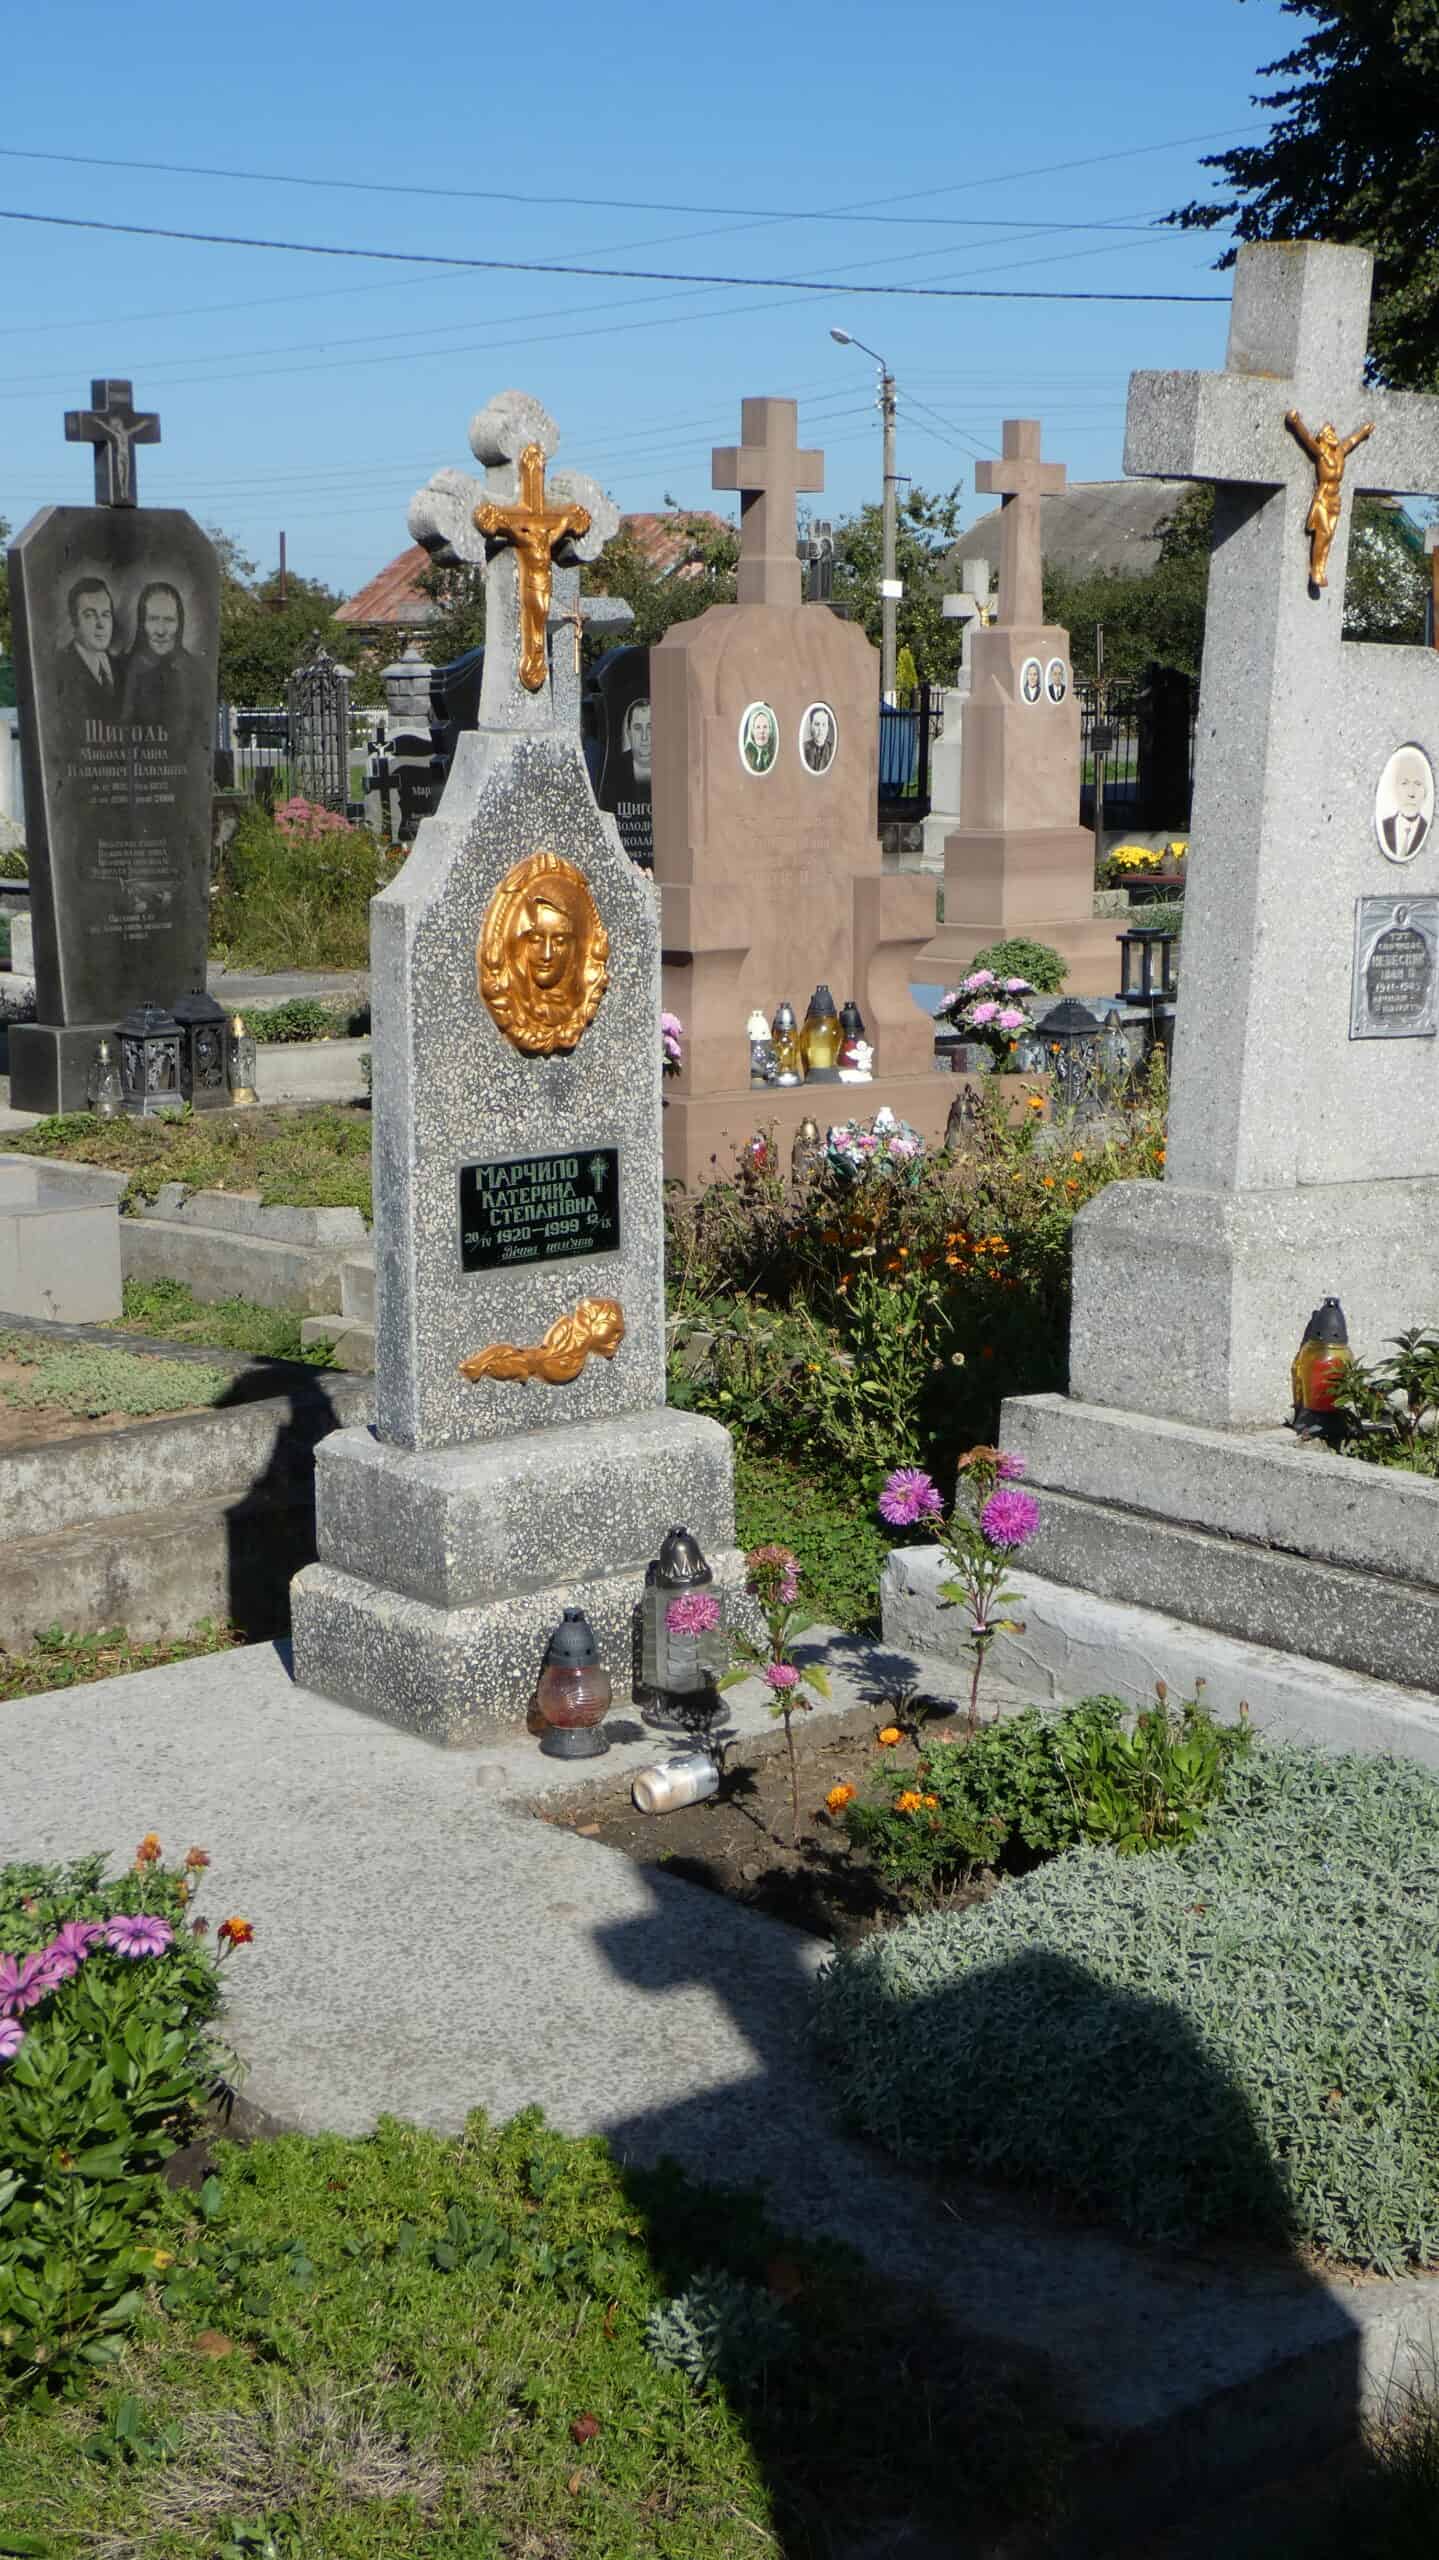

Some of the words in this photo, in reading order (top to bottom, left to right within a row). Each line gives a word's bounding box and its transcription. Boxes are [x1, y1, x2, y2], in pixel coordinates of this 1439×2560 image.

[476, 1158, 579, 1191] МАРЧИЛО
[482, 1181, 577, 1209] КАТЕРИНА
[489, 1195, 599, 1227] СТЕПАНІВНА
